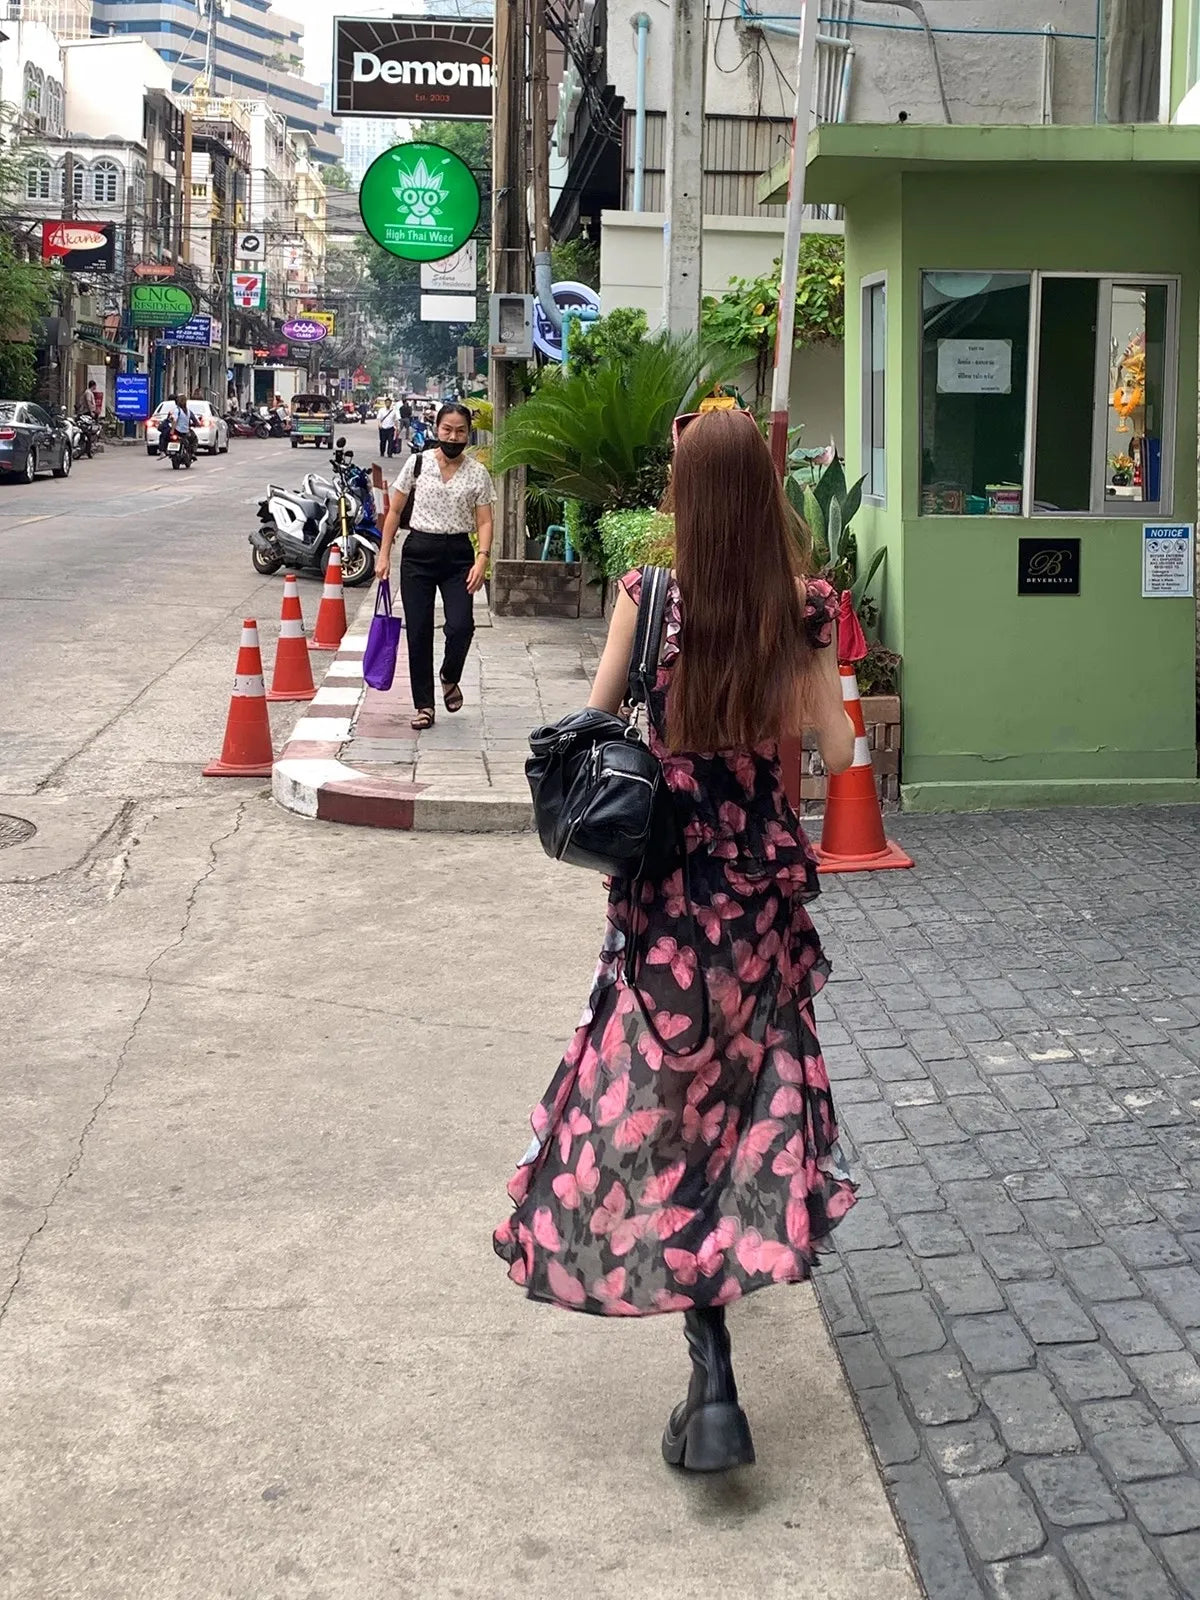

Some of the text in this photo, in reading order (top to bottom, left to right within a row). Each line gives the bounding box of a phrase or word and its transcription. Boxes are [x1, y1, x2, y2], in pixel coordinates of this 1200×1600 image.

[48, 222, 103, 247] Akane
[385, 228, 454, 243] High Thai Weed
[134, 287, 178, 303] CNC
[134, 301, 191, 312] RESIDENCE
[292, 322, 316, 333] 666
[1150, 529, 1184, 537] NOTICE
